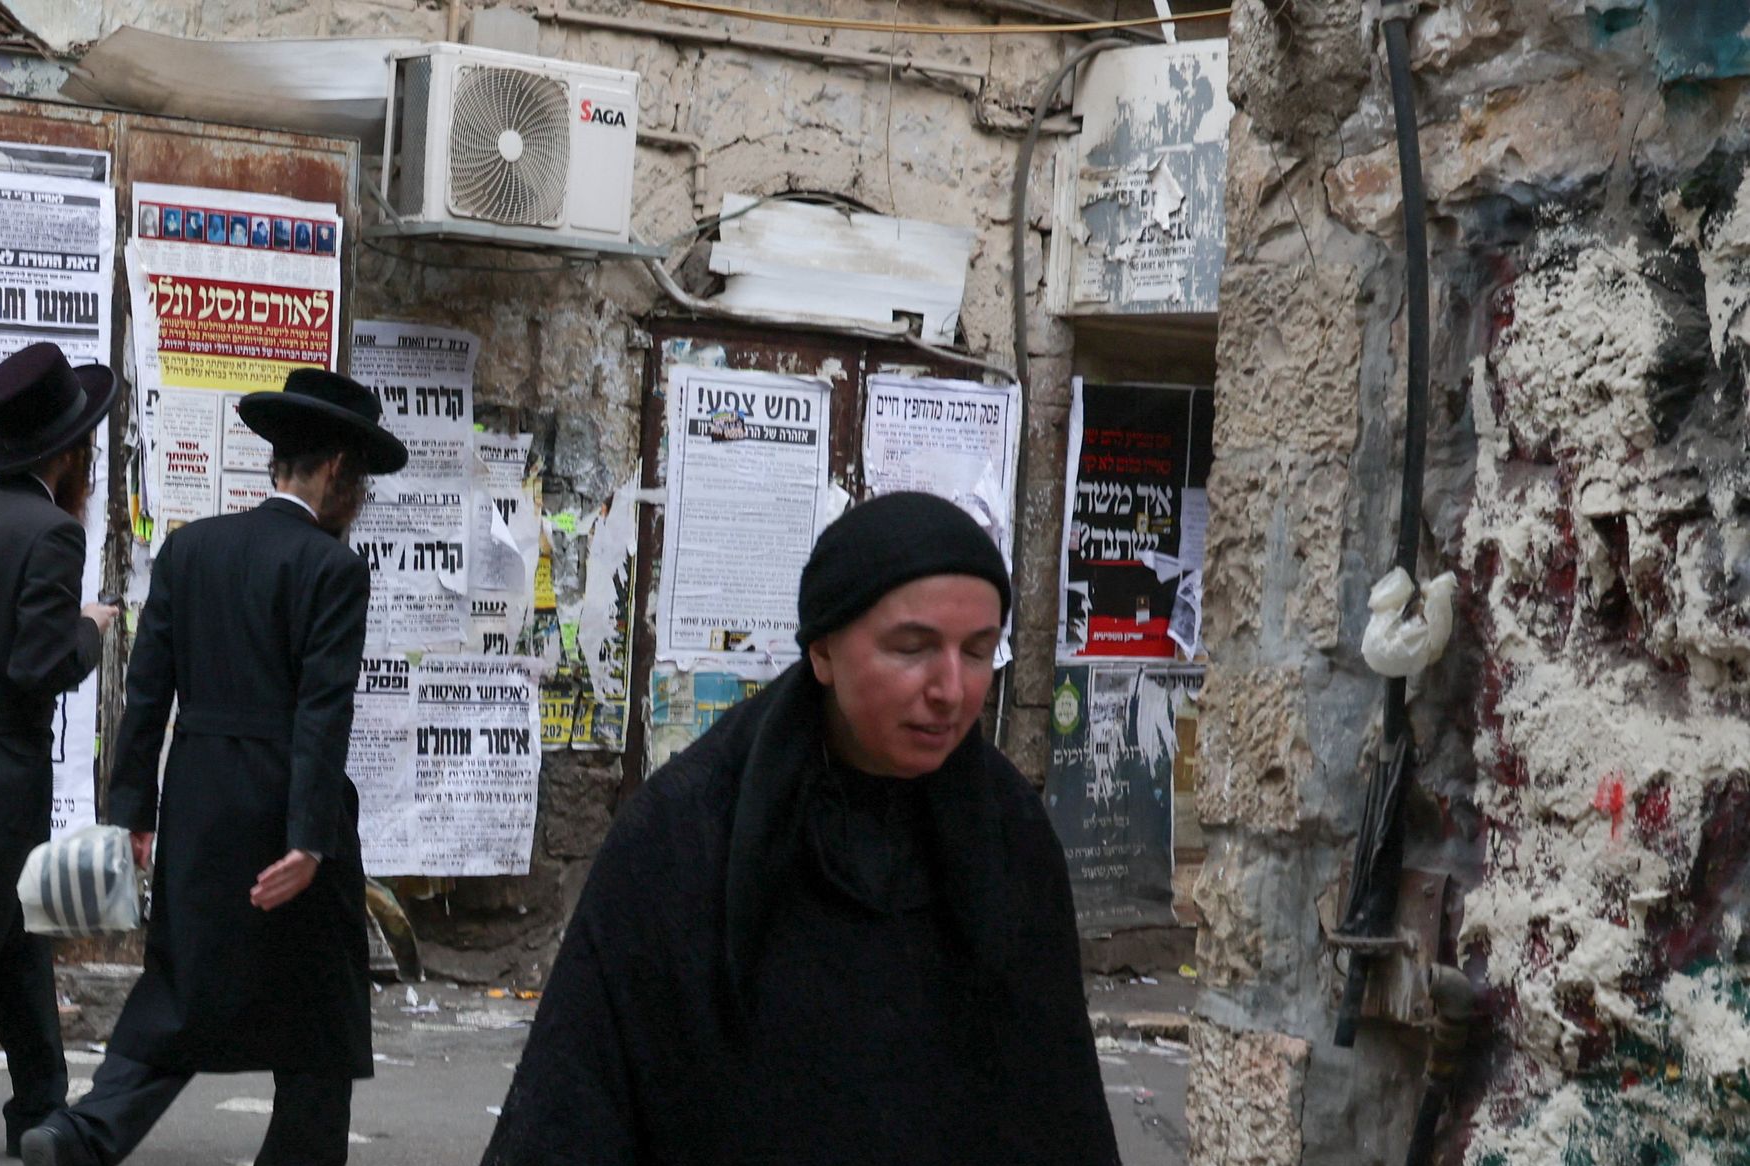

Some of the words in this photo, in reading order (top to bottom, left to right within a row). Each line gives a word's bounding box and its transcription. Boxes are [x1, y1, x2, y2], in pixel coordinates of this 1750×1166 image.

[579, 99, 627, 128] SAGA
[197, 284, 246, 321] נסע
[250, 289, 329, 329] לאורם
[764, 394, 811, 423] נחש
